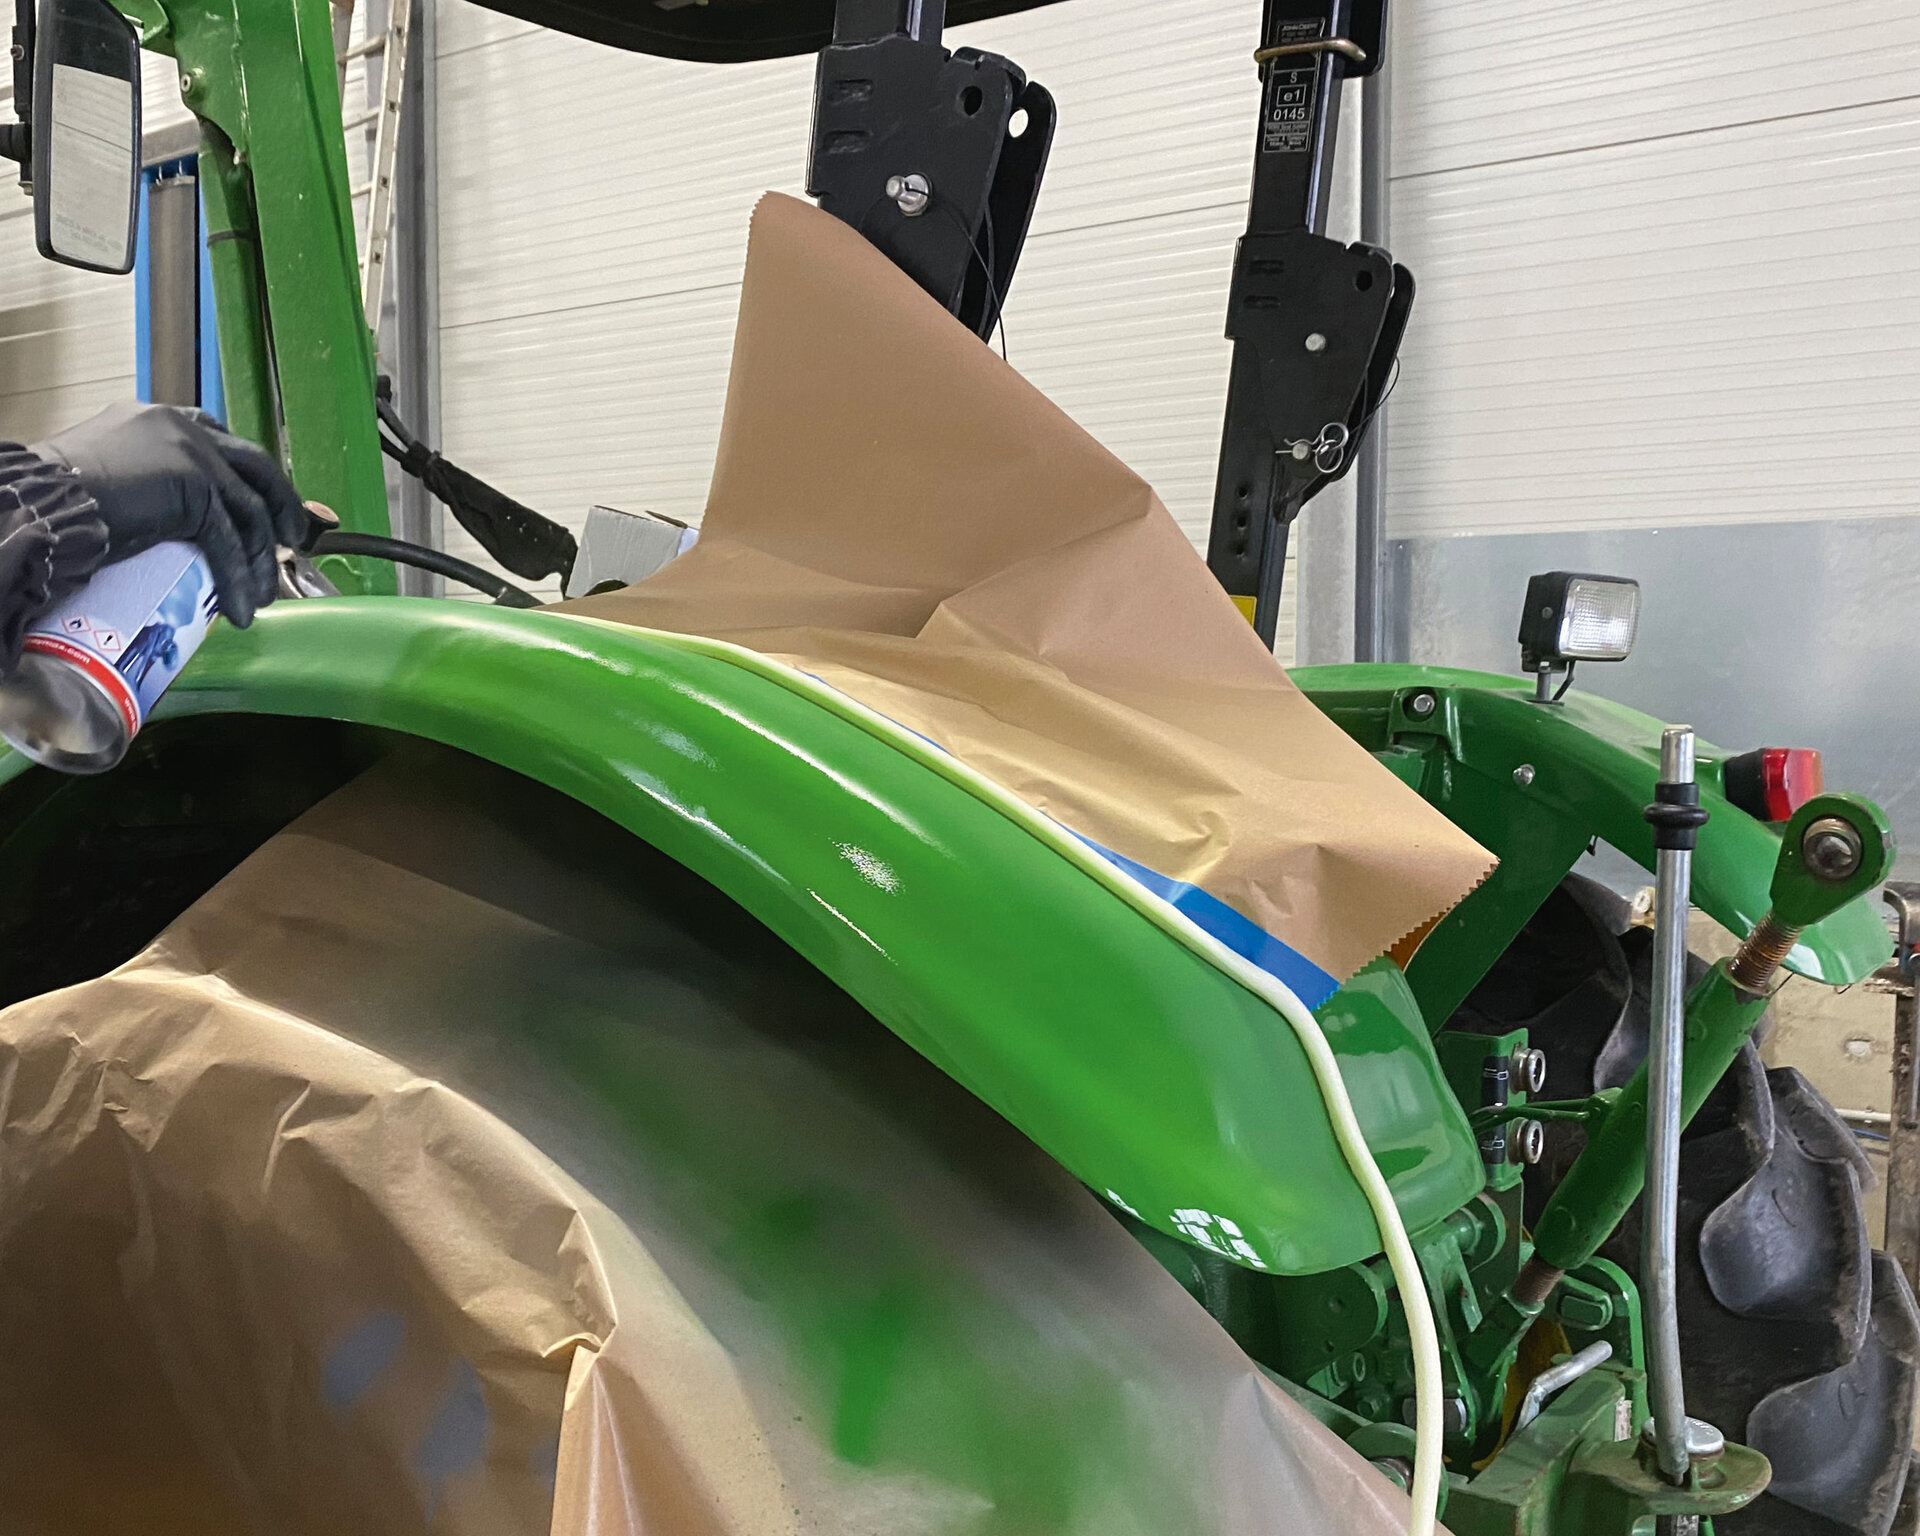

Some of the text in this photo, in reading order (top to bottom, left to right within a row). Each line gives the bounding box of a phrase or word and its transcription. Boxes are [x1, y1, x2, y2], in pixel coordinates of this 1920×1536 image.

[1290, 72, 1298, 84] S
[1283, 89, 1300, 102] e1
[1273, 107, 1306, 121] 0145
